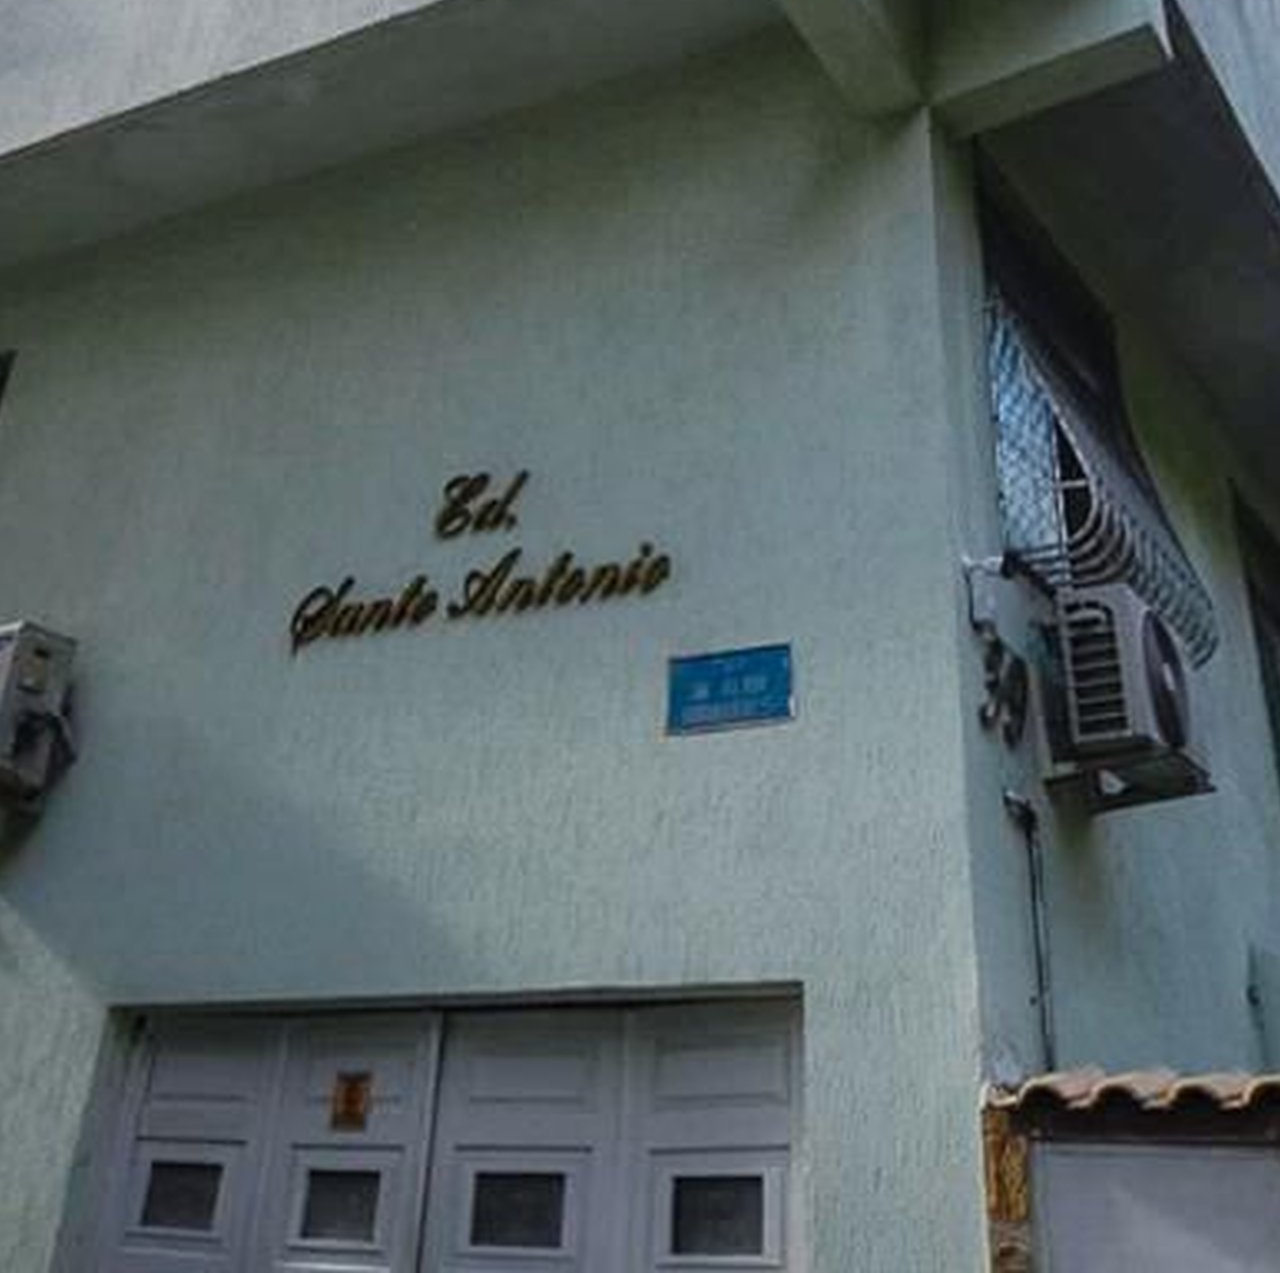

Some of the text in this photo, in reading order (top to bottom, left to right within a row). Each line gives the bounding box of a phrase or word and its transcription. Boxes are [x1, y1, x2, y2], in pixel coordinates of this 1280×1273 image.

[434, 468, 531, 540] Ed.
[288, 541, 673, 659] Santo Antonio
